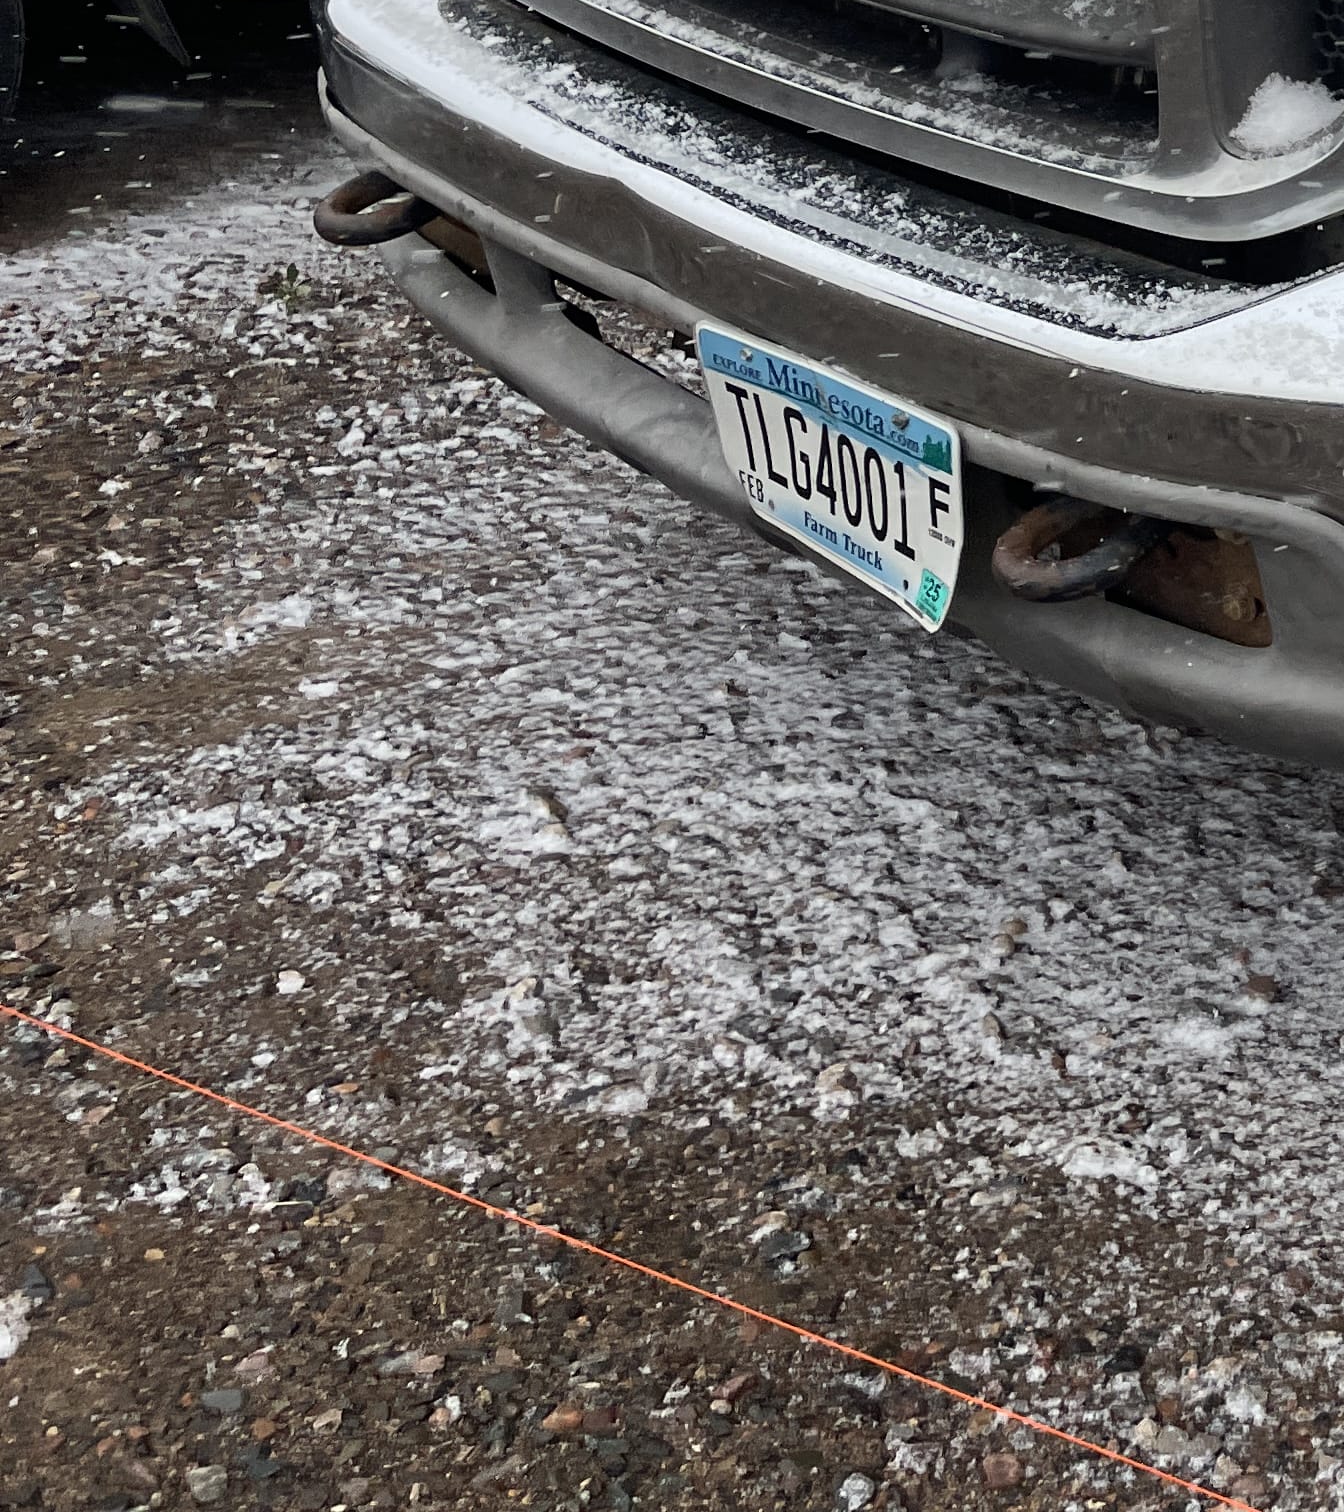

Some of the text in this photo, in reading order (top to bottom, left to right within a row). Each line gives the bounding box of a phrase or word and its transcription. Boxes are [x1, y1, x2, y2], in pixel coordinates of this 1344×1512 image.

[725, 381, 951, 562] TLG4001 F
[739, 470, 764, 503] FEB
[804, 511, 838, 546] Farm
[843, 533, 883, 581] Truck
